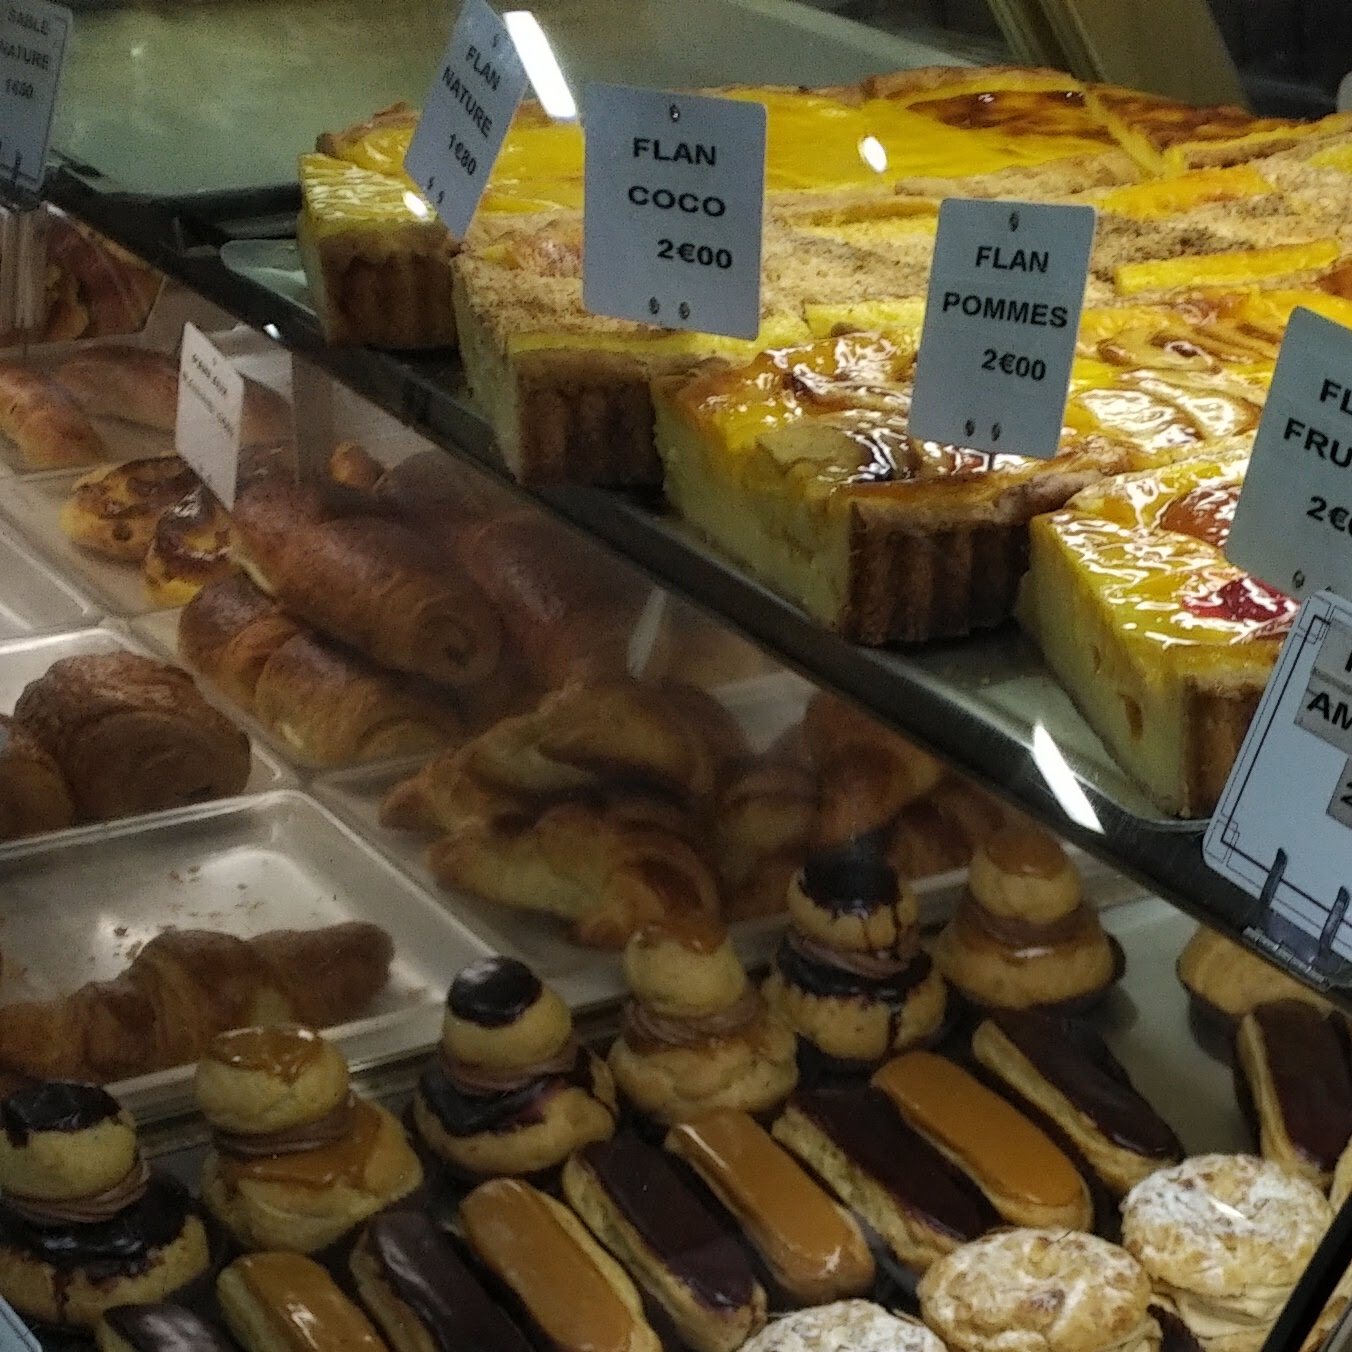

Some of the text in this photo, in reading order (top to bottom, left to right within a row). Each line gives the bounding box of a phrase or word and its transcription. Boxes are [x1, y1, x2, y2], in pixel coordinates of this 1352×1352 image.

[466, 45, 501, 91] FLAN
[443, 66, 493, 138] NATURE
[449, 133, 477, 176] 1€80
[633, 137, 716, 166] FLAN
[628, 185, 726, 217] COCO
[657, 238, 733, 269] 2€00
[975, 246, 1049, 273] FLAN
[942, 291, 1068, 329] POMMES
[981, 348, 1047, 381] 2€00
